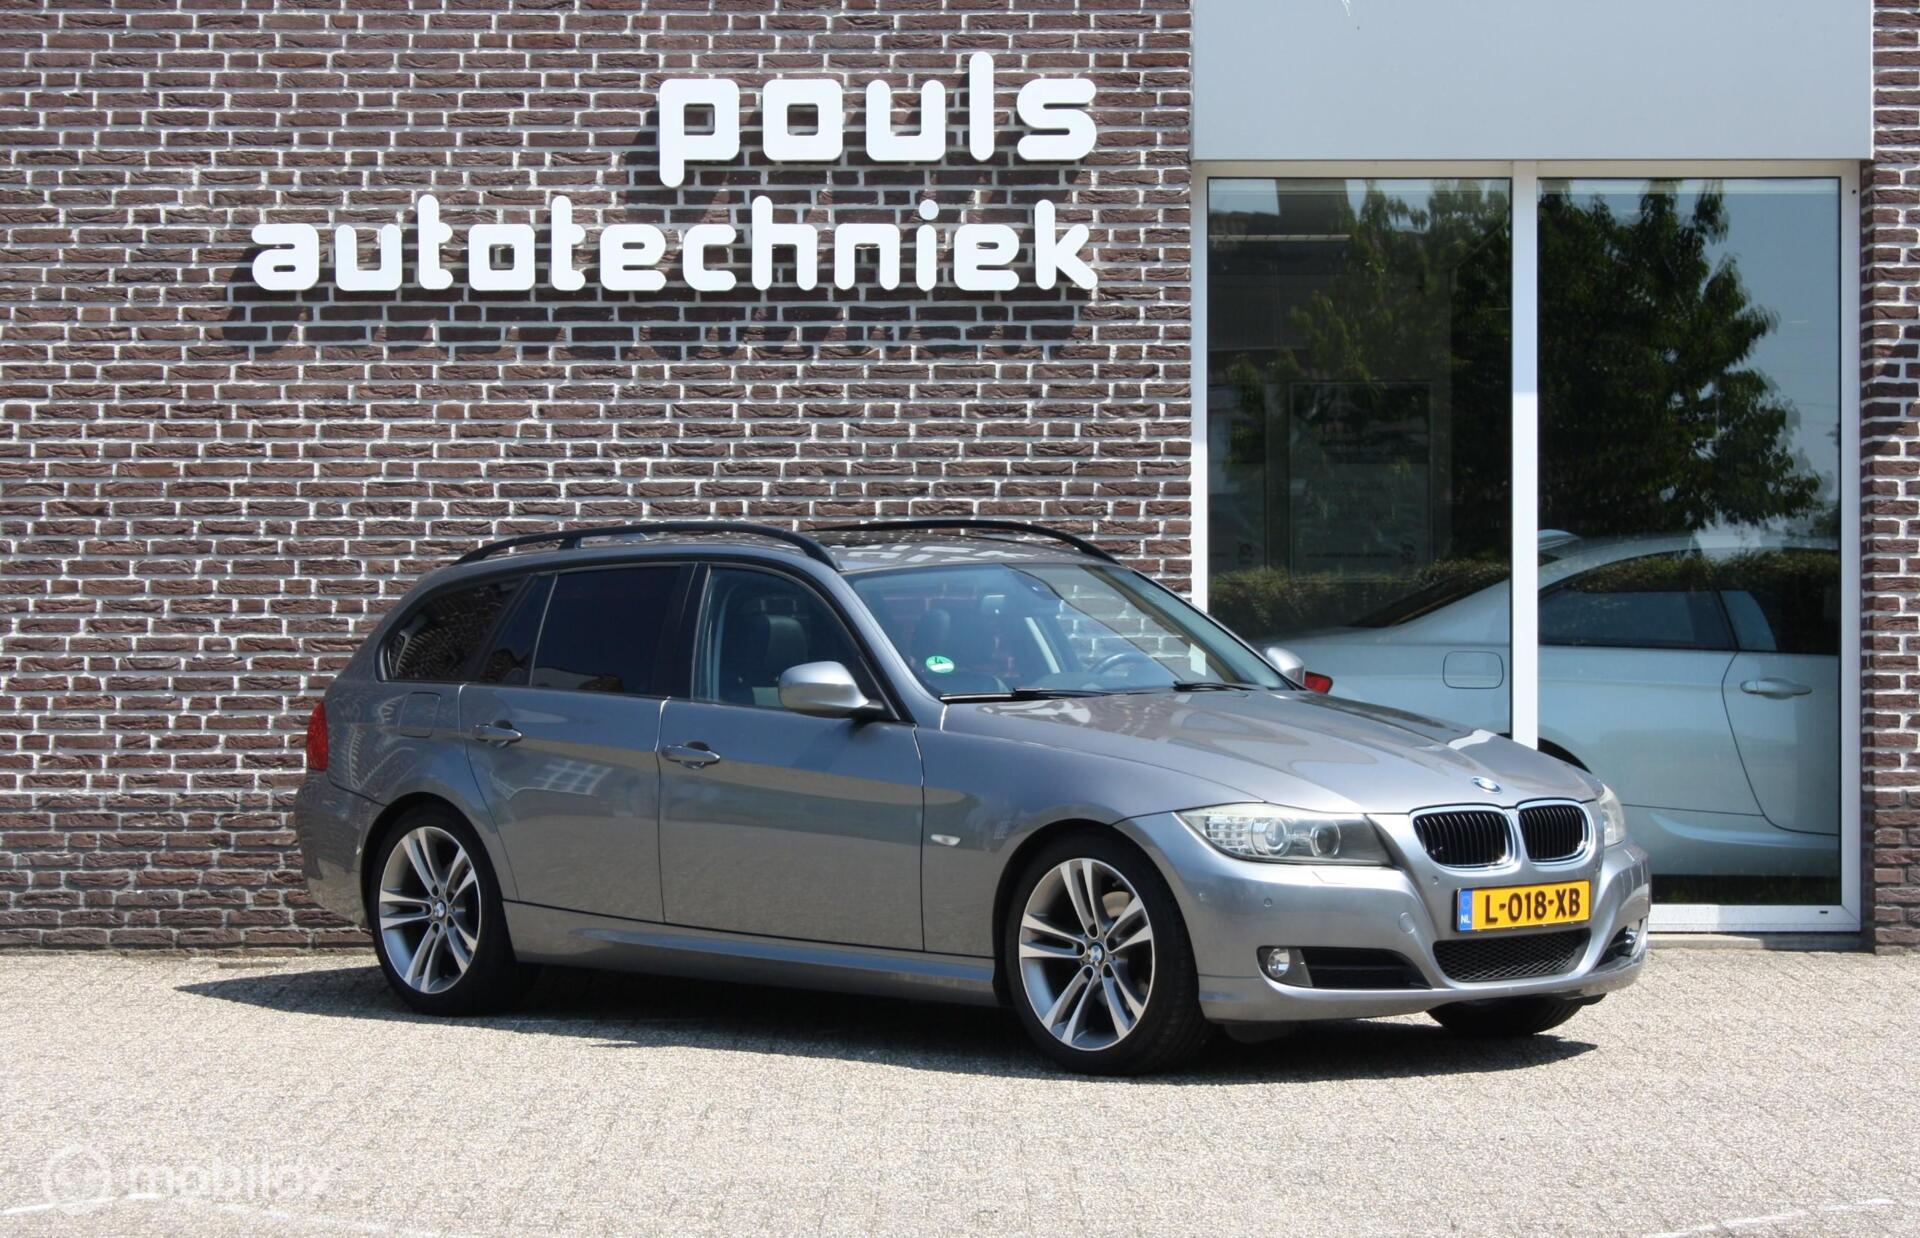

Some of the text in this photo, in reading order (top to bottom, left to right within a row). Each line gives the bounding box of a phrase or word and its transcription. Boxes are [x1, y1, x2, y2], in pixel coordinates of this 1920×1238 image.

[656, 51, 1097, 188] pouls
[250, 194, 1098, 292] autotechniek
[1460, 914, 1471, 924] NL
[1485, 887, 1581, 925] L-018-XB
